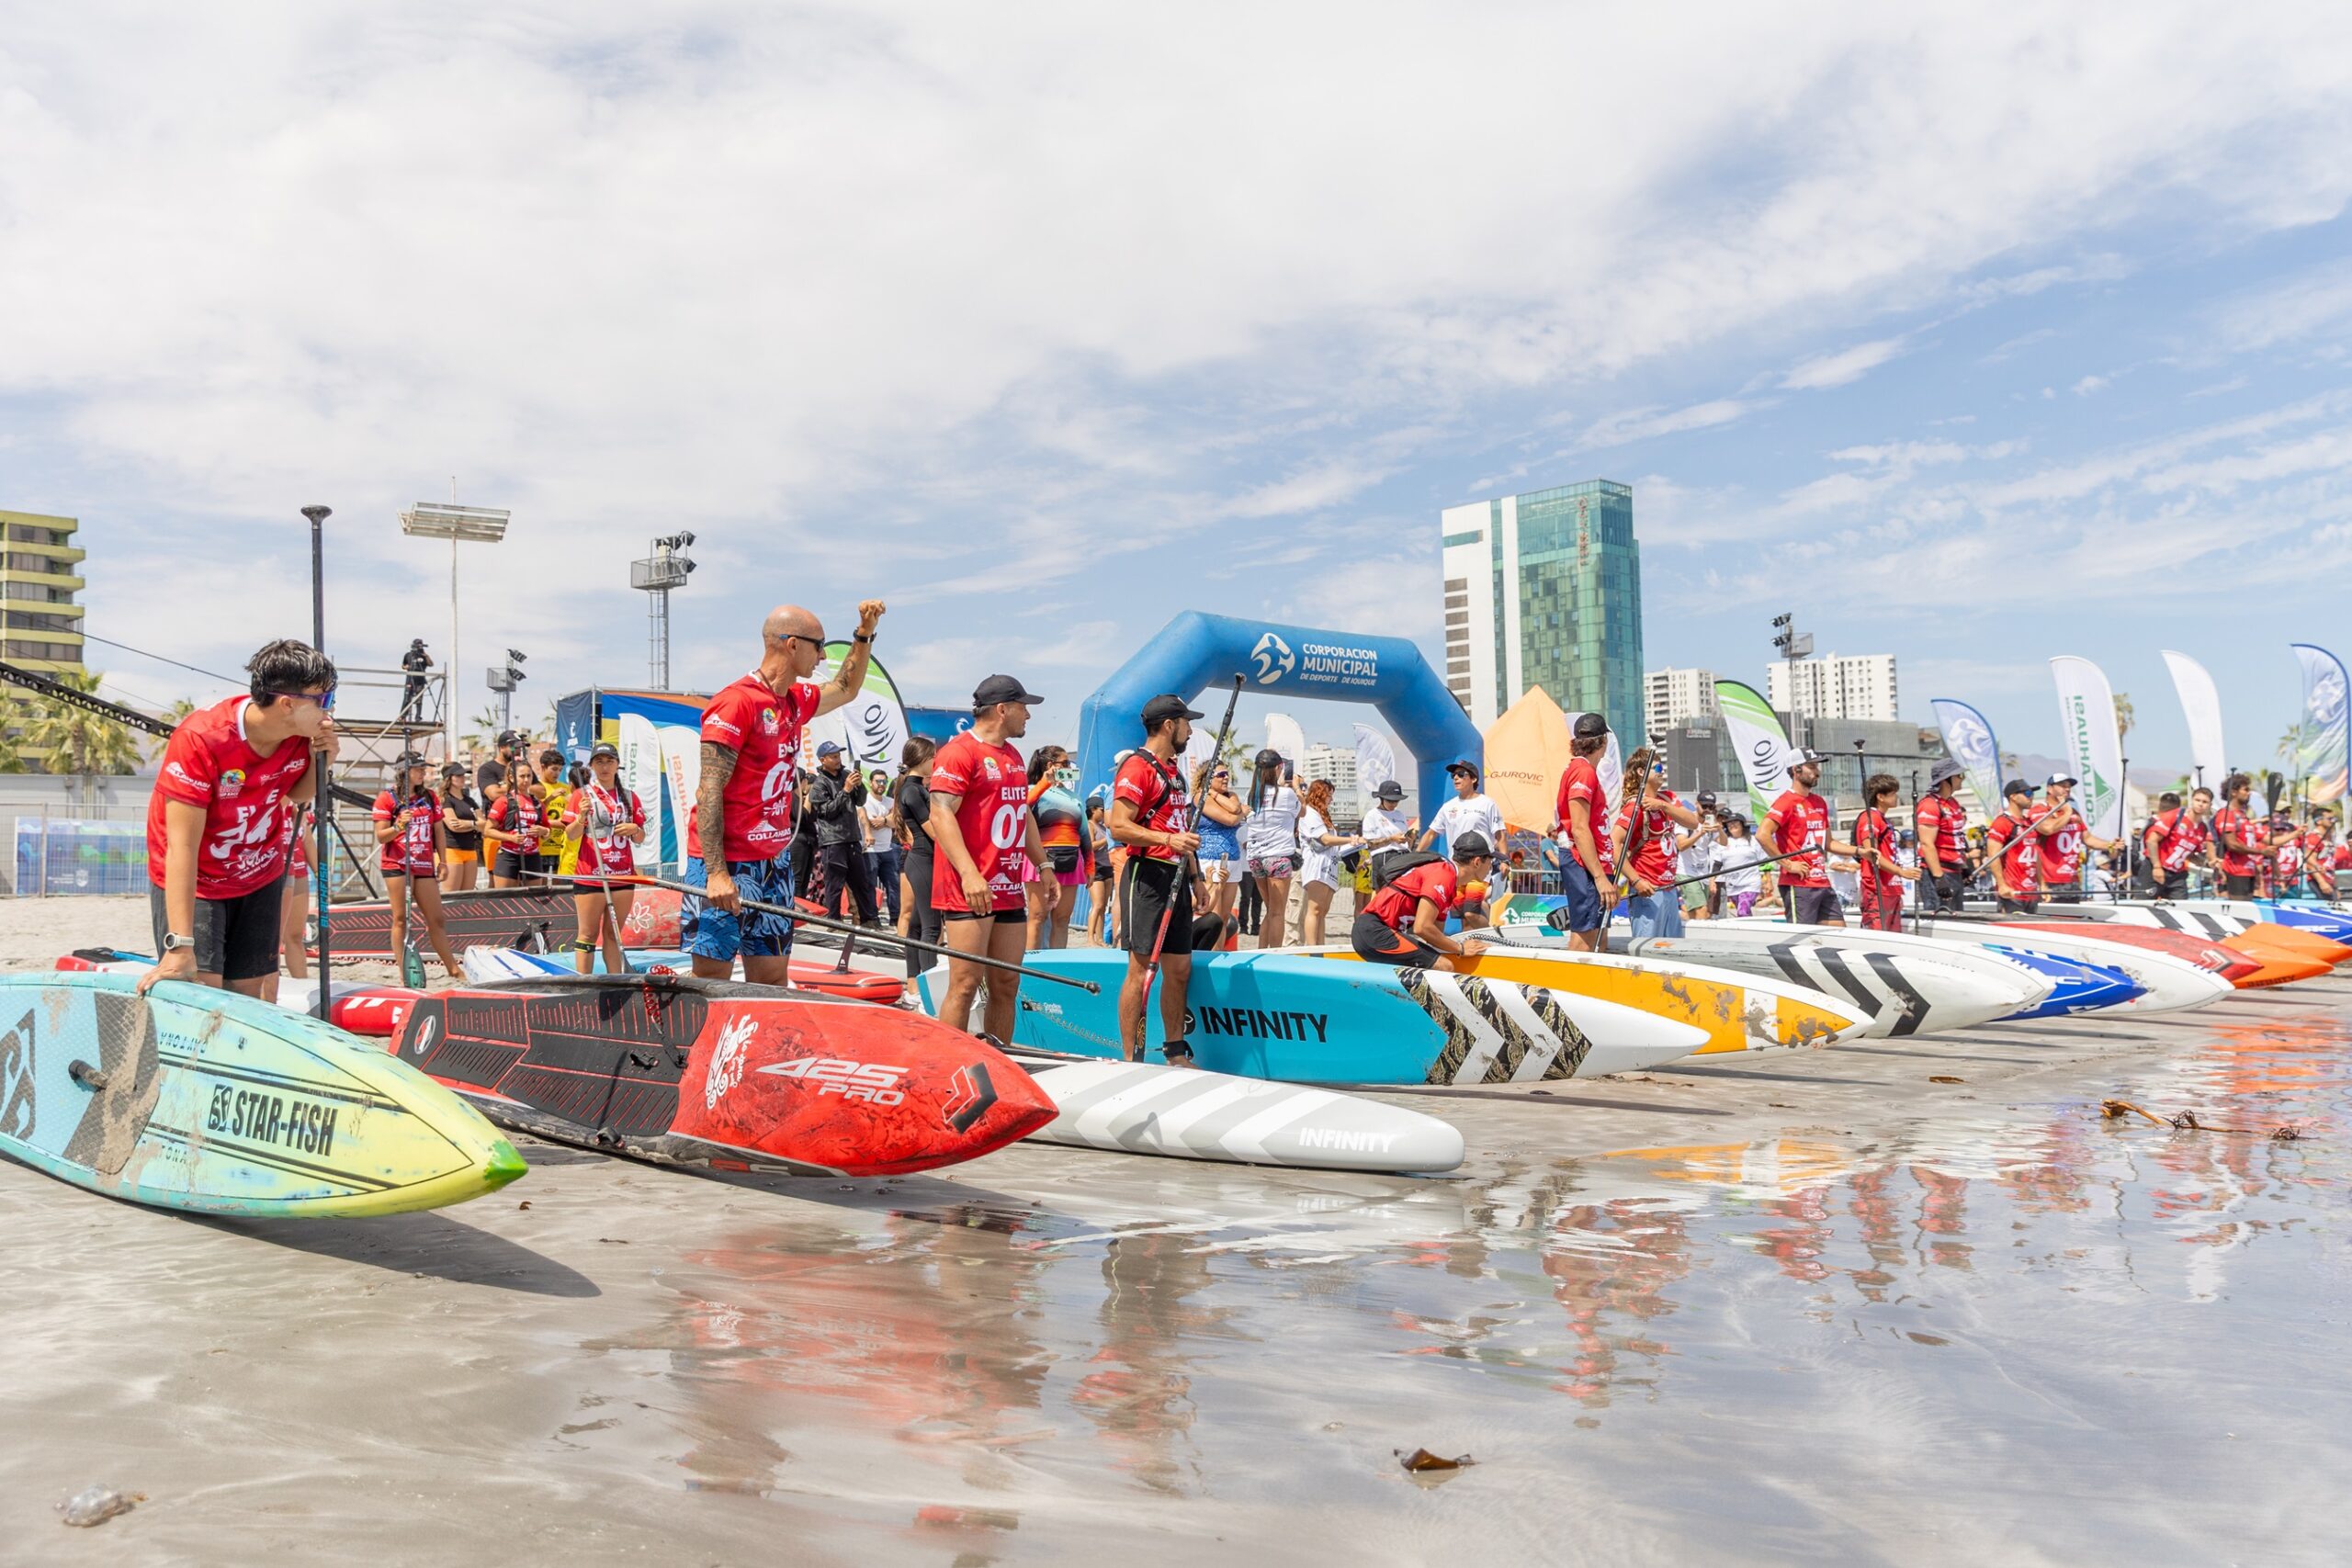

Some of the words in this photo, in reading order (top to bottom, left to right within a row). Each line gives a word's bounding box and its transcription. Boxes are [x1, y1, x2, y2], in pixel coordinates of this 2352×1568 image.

[1303, 643, 1377, 660] CORPORACION
[1302, 656, 1378, 676] MUNICIPAL
[1309, 673, 1338, 682] DEPORTE
[1351, 678, 1376, 686] IQUIQUE
[1490, 771, 1544, 782] GJUROVIC
[1001, 787, 1026, 801] ELITE
[1199, 1006, 1329, 1043] INFINITY
[755, 1056, 910, 1089] 425
[818, 1081, 905, 1106] PRO
[232, 1090, 338, 1156] STAR-FISH
[1298, 1127, 1396, 1154] INFINITY
